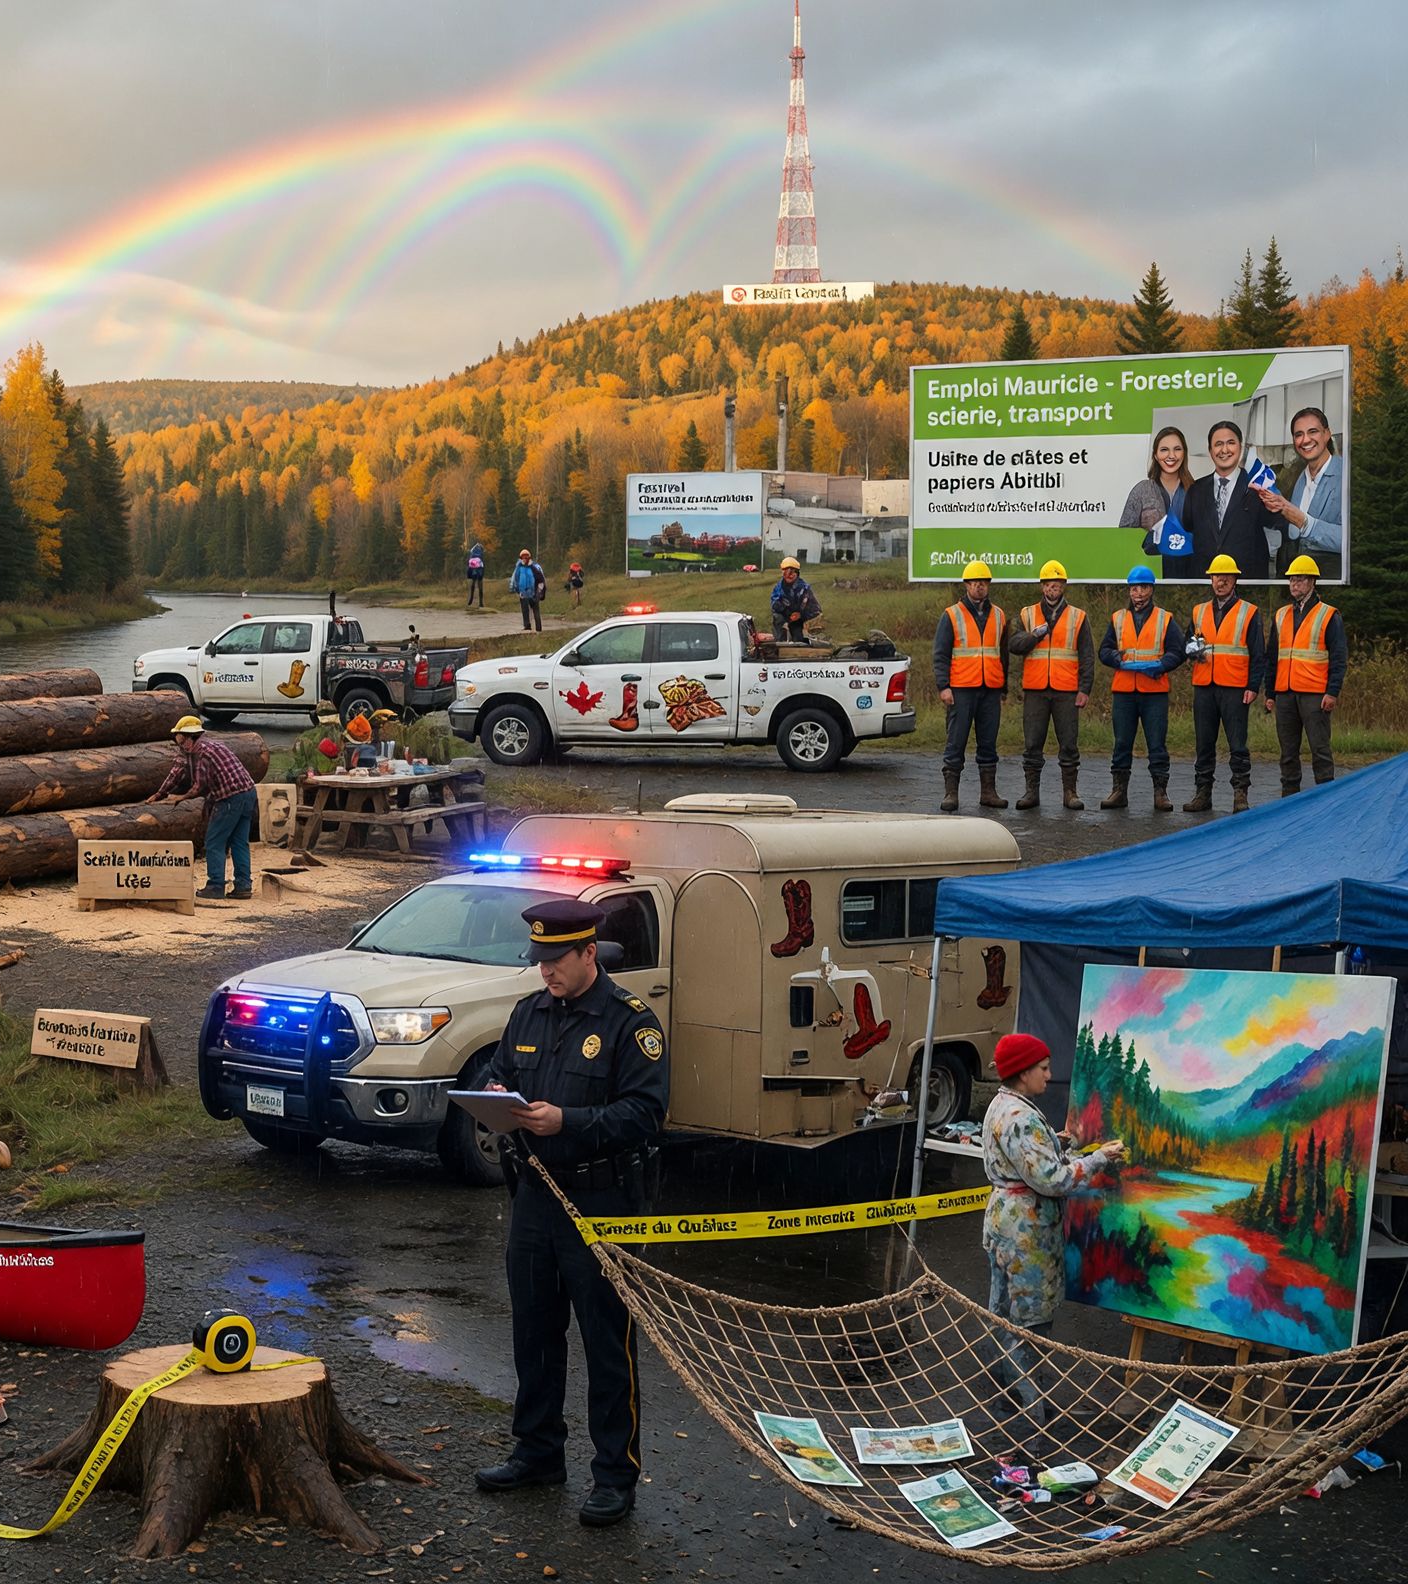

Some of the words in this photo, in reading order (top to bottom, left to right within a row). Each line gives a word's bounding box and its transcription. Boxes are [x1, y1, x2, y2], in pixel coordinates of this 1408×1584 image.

[928, 377, 998, 402] Emploi
[1004, 374, 1099, 396] Mauricie
[1121, 367, 1243, 392] Foresterie,
[927, 406, 1003, 427] scierie,
[1008, 402, 1113, 427] transport
[983, 450, 1006, 466] de
[1068, 449, 1089, 465] et
